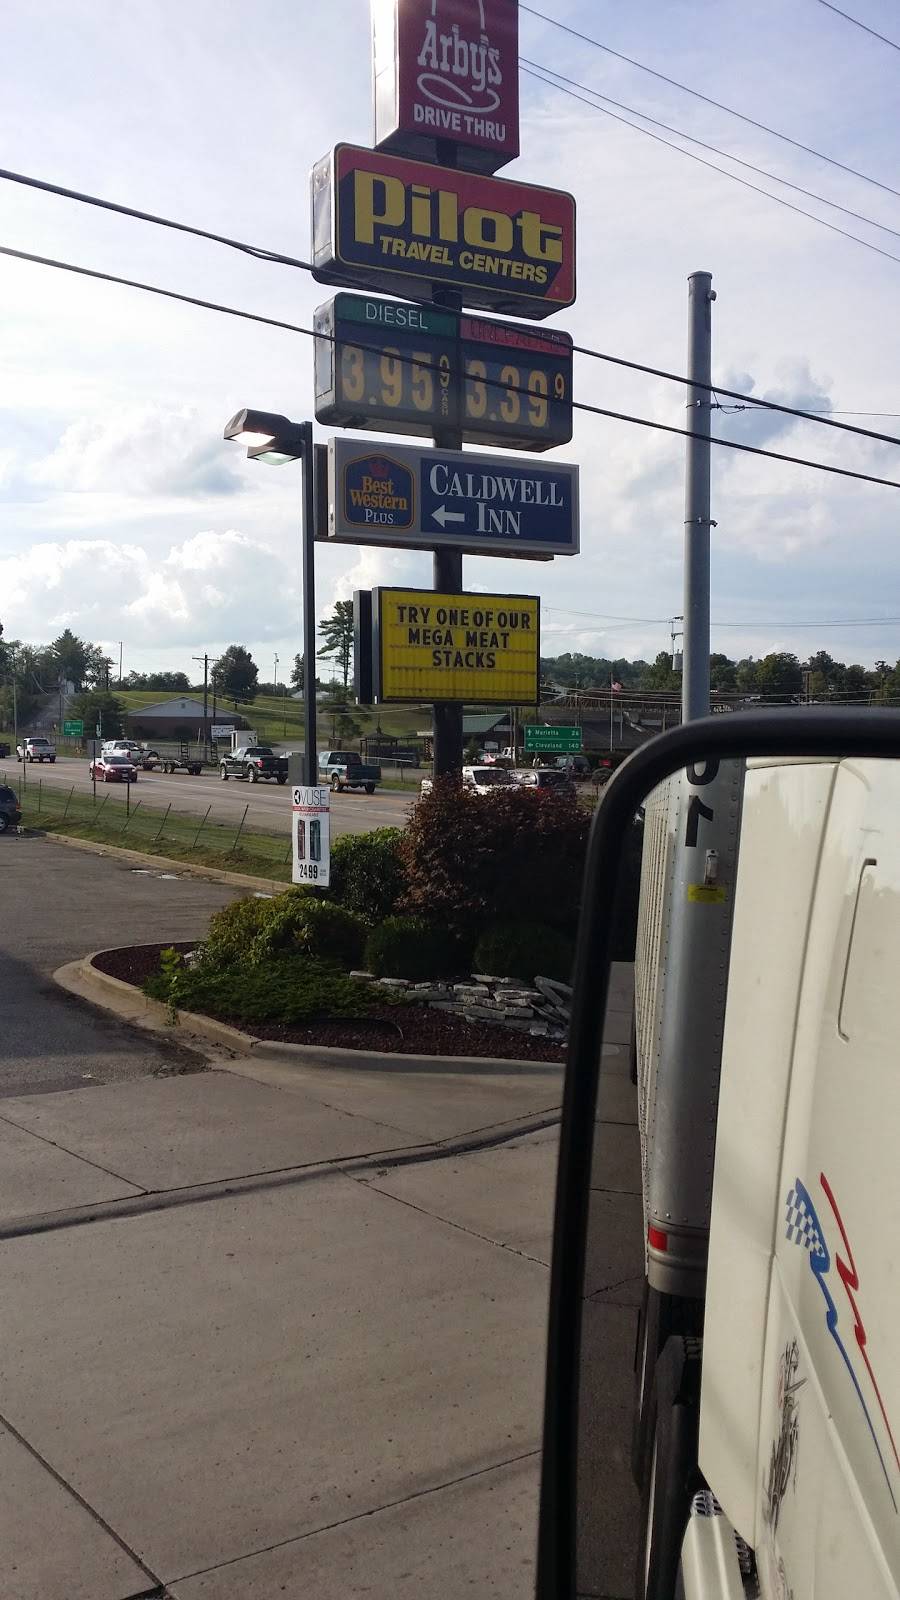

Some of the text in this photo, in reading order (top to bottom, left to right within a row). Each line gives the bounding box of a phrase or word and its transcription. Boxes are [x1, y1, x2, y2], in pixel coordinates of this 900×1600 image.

[417, 19, 502, 92] Arby's
[413, 103, 506, 142] DRIVE THRU
[379, 235, 548, 284] TRAVEL CENTERS
[365, 302, 428, 330] DIESEL
[362, 476, 394, 495] Best
[429, 464, 563, 507] CALDWELL
[350, 488, 408, 510] Western
[477, 502, 522, 535] INN
[397, 605, 530, 629] TRY ONE OF OUR
[408, 627, 510, 649] MEGA MEAT
[432, 650, 496, 669] STACKS
[301, 789, 326, 806] VUSE
